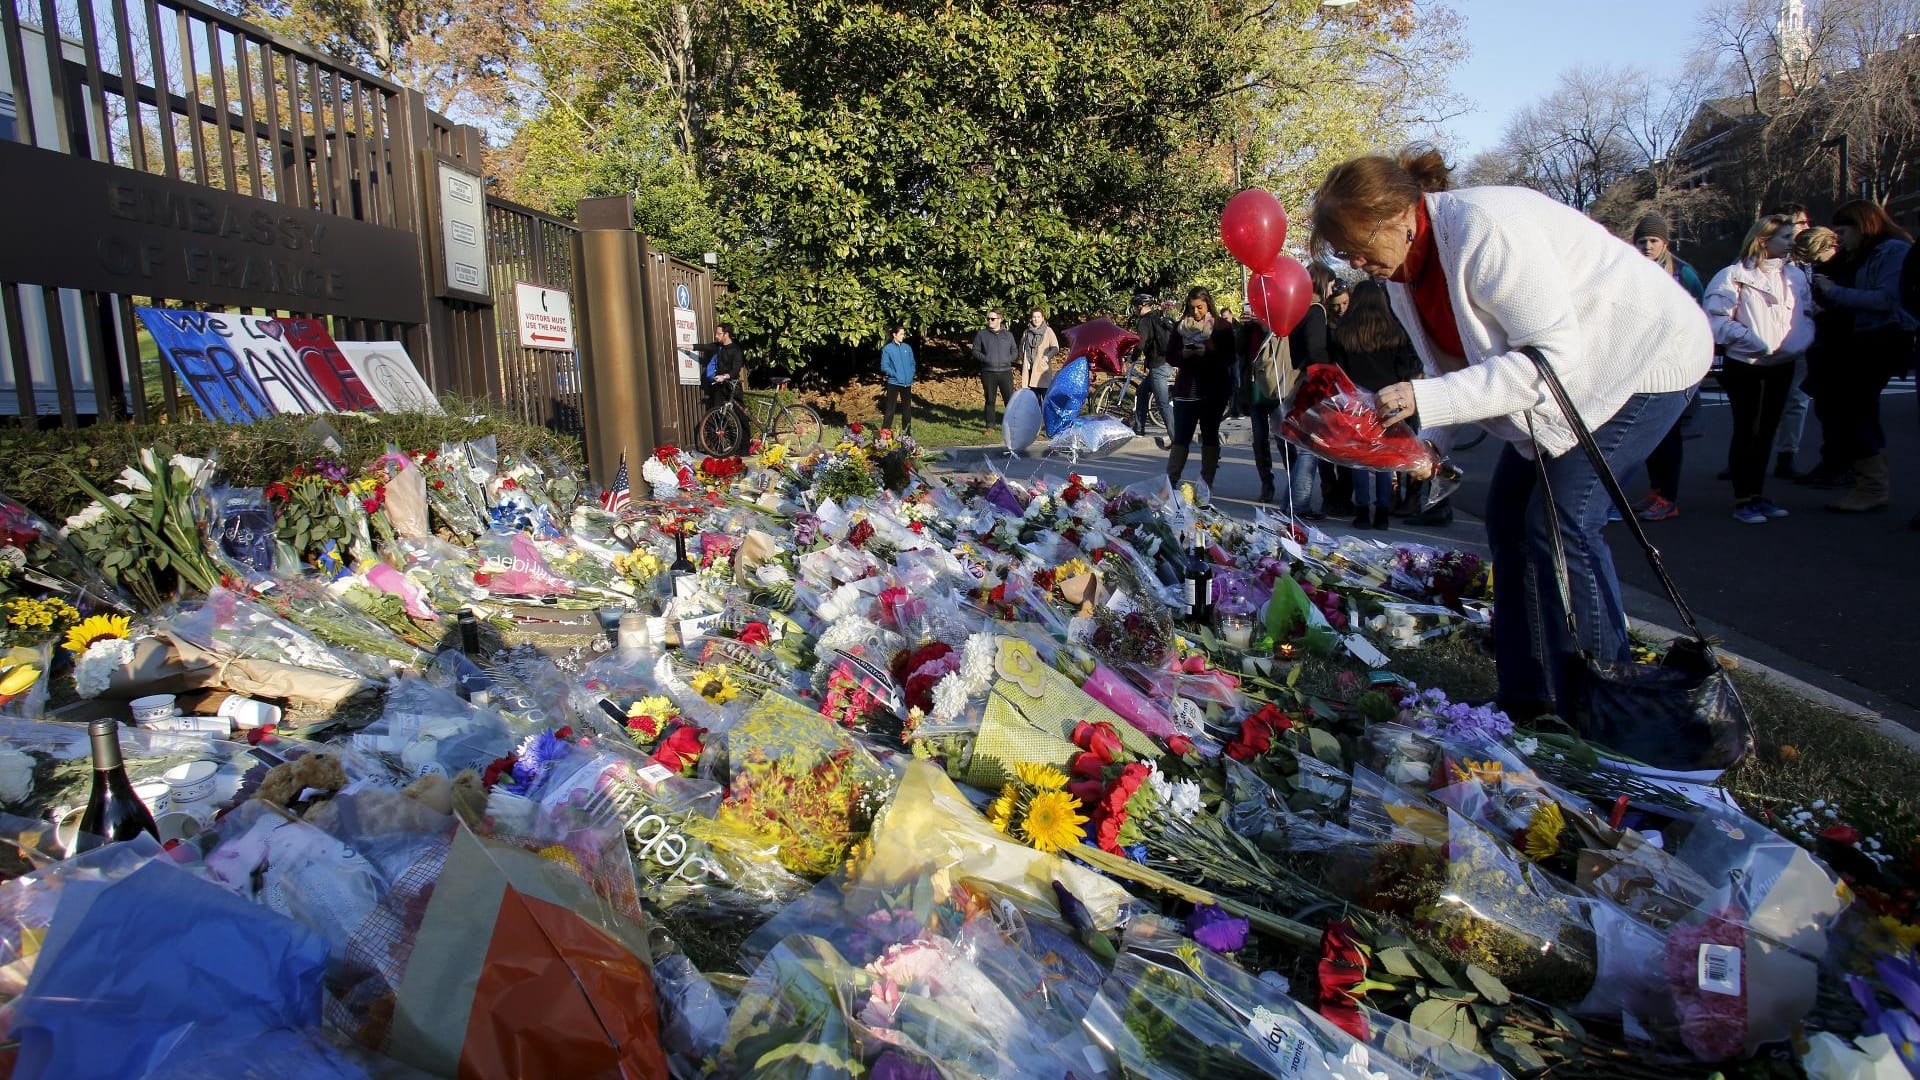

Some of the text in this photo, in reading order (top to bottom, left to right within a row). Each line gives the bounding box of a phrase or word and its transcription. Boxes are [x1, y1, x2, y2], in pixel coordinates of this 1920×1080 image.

[107, 179, 328, 255] EMBASSY
[97, 233, 345, 301] OF FRANCE
[158, 310, 235, 338] We
[525, 313, 567, 325] VISITORS MUST
[525, 322, 568, 333] USE THE PHONE
[171, 346, 381, 421] FRANCE
[1263, 1022, 1289, 1054] day
